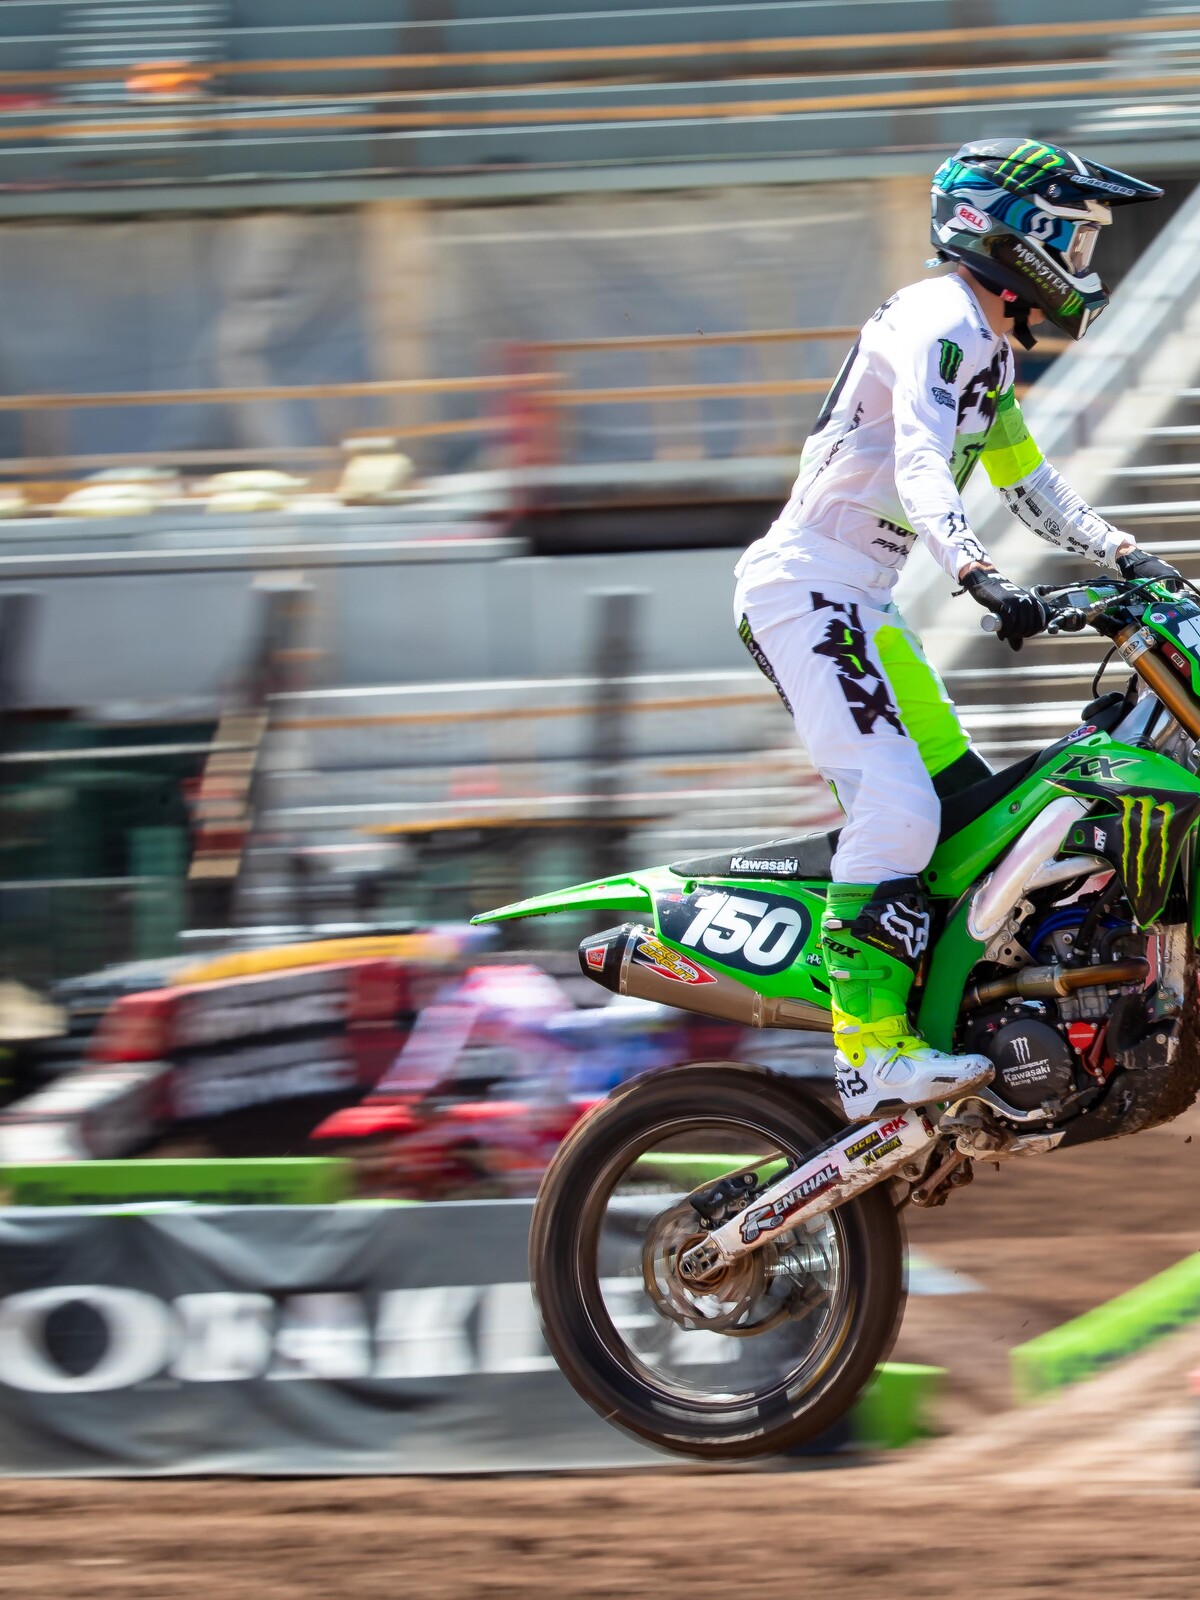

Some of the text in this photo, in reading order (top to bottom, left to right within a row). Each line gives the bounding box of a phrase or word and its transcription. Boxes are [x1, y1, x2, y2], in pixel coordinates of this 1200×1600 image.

[959, 207, 985, 229] BELL
[1013, 243, 1070, 295] MONSTER
[1050, 753, 1146, 782] KX
[730, 857, 799, 871] Kawasaki
[680, 892, 802, 966] 150
[648, 940, 680, 962] PRO
[806, 953, 822, 965] PPG
[823, 937, 861, 959] FOX
[638, 944, 696, 981] CIRCUIT
[1003, 1063, 1051, 1083] Kawasaki
[1010, 1074, 1047, 1087] Racing Team
[880, 1115, 909, 1137] RK
[846, 1131, 879, 1157] EXCEL
[740, 1164, 840, 1243] RENTHAL
